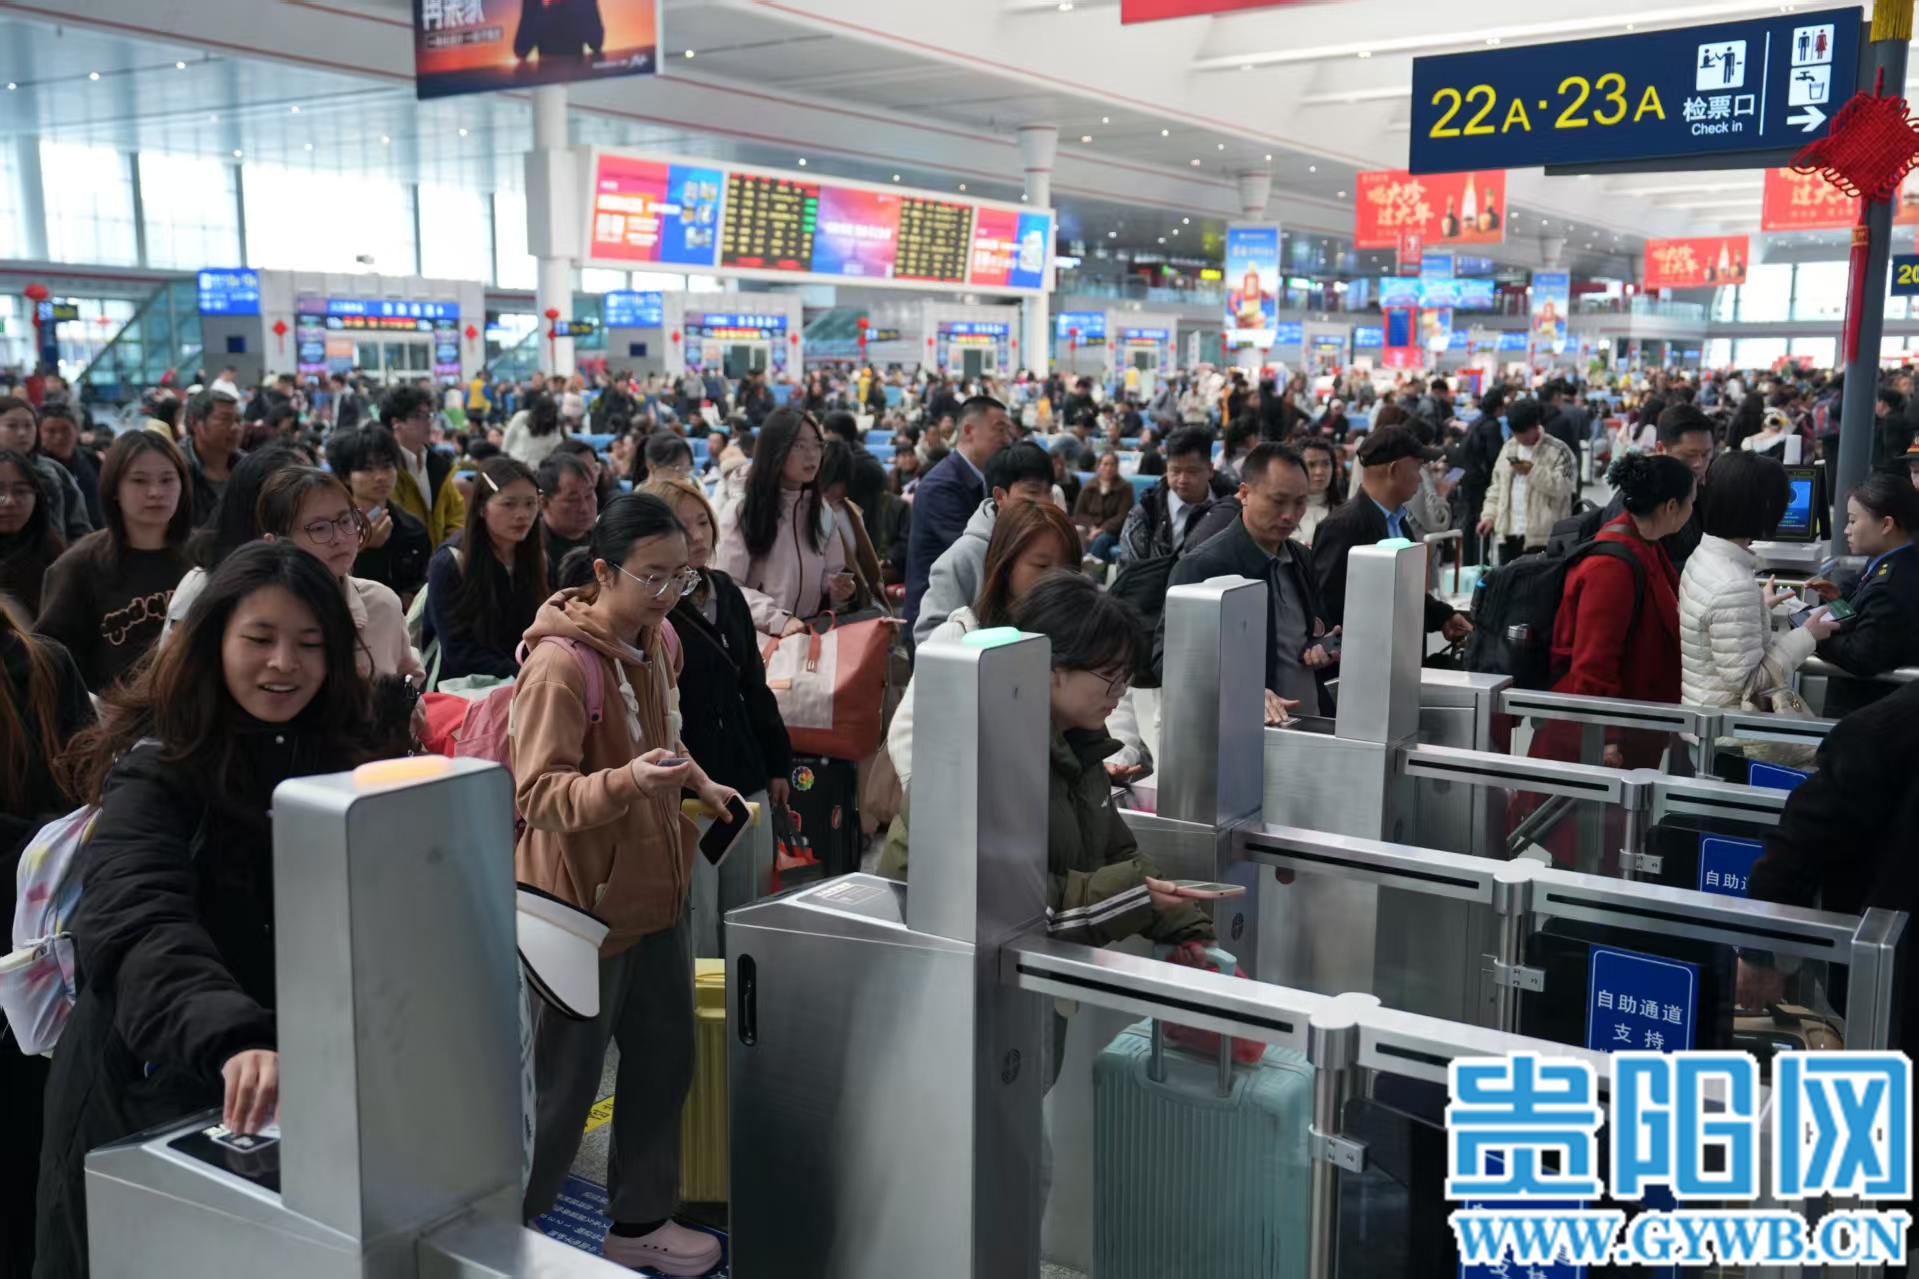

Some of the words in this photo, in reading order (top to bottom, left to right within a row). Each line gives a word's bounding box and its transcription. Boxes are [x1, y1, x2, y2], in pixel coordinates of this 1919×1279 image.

[1682, 94, 1755, 122] 检票口
[1691, 121, 1729, 136] Check
[1731, 120, 1743, 132] in
[1791, 182, 1854, 206] 过大
[1598, 989, 1683, 1025] 自助通道
[1613, 1022, 1665, 1050] 支持
